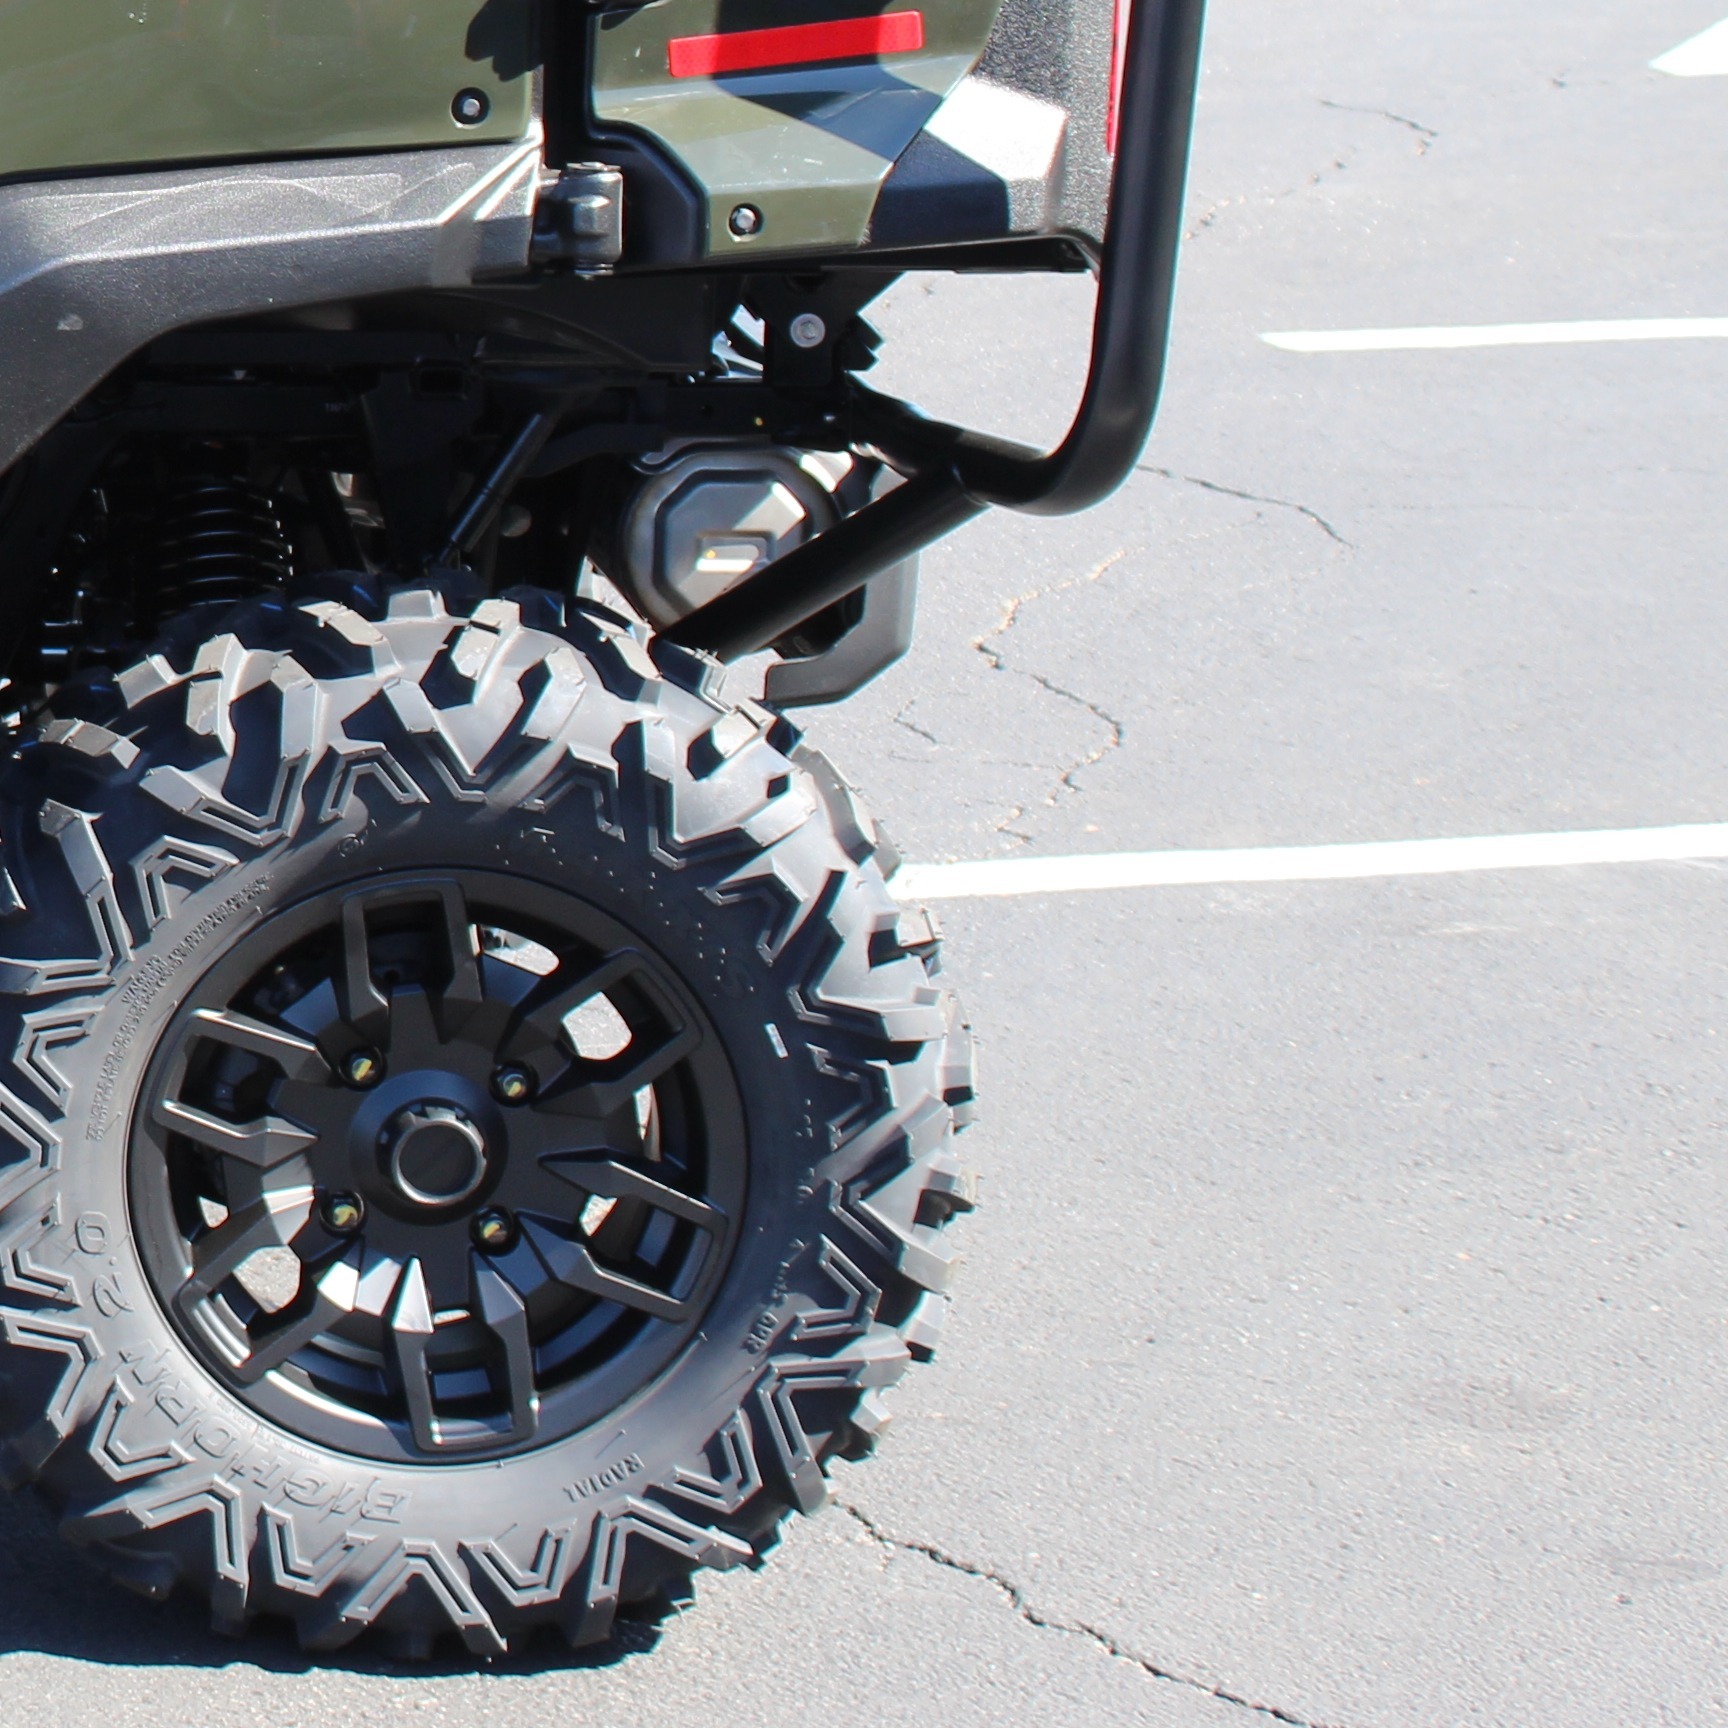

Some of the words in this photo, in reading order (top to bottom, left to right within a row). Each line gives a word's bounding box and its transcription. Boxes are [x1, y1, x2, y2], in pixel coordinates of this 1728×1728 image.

[74, 1210, 135, 1320] 2.0
[117, 1338, 416, 1524] BIGHORN
[562, 1452, 646, 1504] RADIAL
